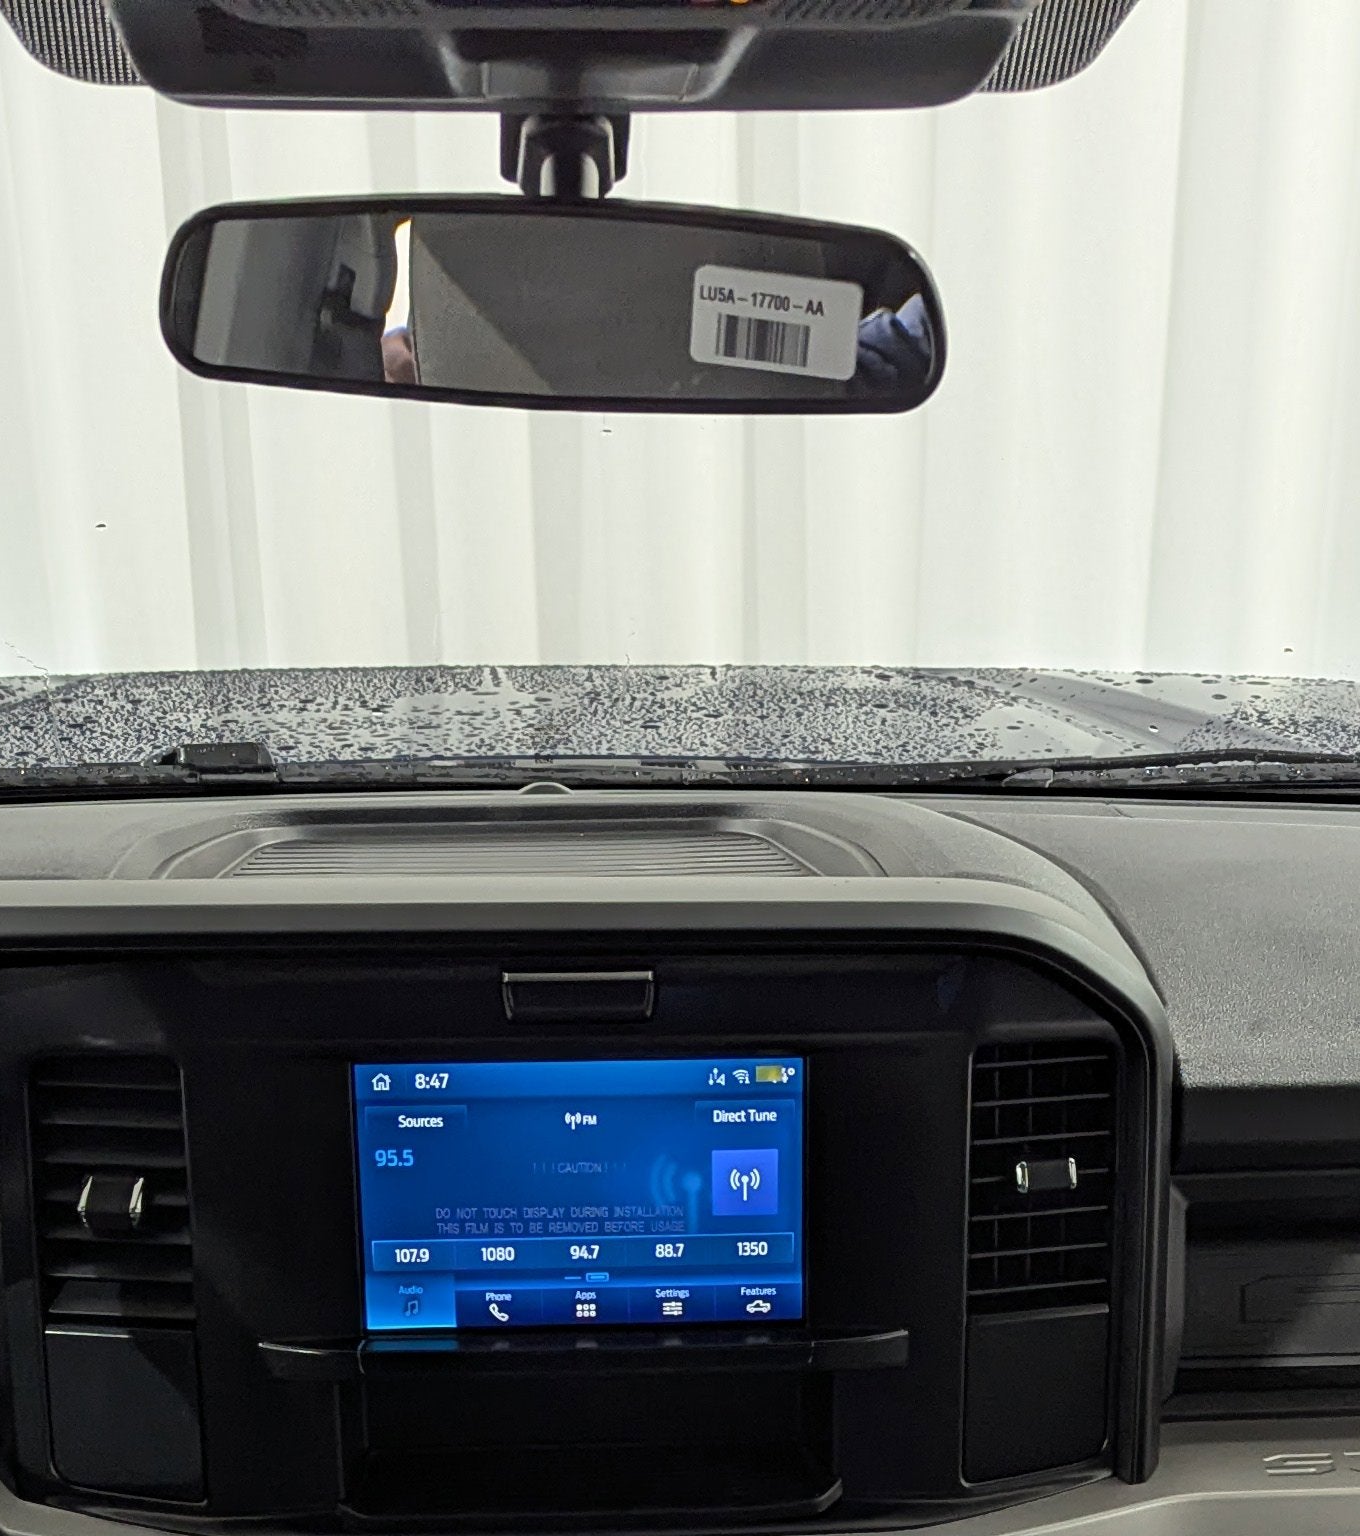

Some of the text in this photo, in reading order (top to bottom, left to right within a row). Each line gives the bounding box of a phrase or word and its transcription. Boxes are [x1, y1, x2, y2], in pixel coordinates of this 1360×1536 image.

[414, 1072, 450, 1090] 8:47
[398, 1115, 444, 1129] Sources
[582, 1114, 598, 1126] FM
[713, 1108, 778, 1123] Direct Tune
[374, 1148, 414, 1168] 95.5
[435, 1205, 685, 1220] DO NOT TOUCH DISPLAY DURING INSTALLATION
[437, 1222, 460, 1235] THIS
[465, 1222, 489, 1235] FILM
[510, 1222, 524, 1234] TO
[529, 1222, 544, 1234] BE
[548, 1221, 600, 1234] REMOVED
[604, 1221, 645, 1233] BEFORE
[650, 1220, 686, 1232] USAGE
[394, 1248, 430, 1264] 107.9
[480, 1246, 516, 1262] 1080
[569, 1245, 600, 1261] 94.7
[654, 1243, 684, 1259] 88.7
[736, 1241, 768, 1257] 1350
[397, 1285, 424, 1295] Audio
[485, 1291, 512, 1302] Phone
[575, 1290, 597, 1301] Apps
[655, 1287, 690, 1300] Settings
[740, 1286, 777, 1297] Features
